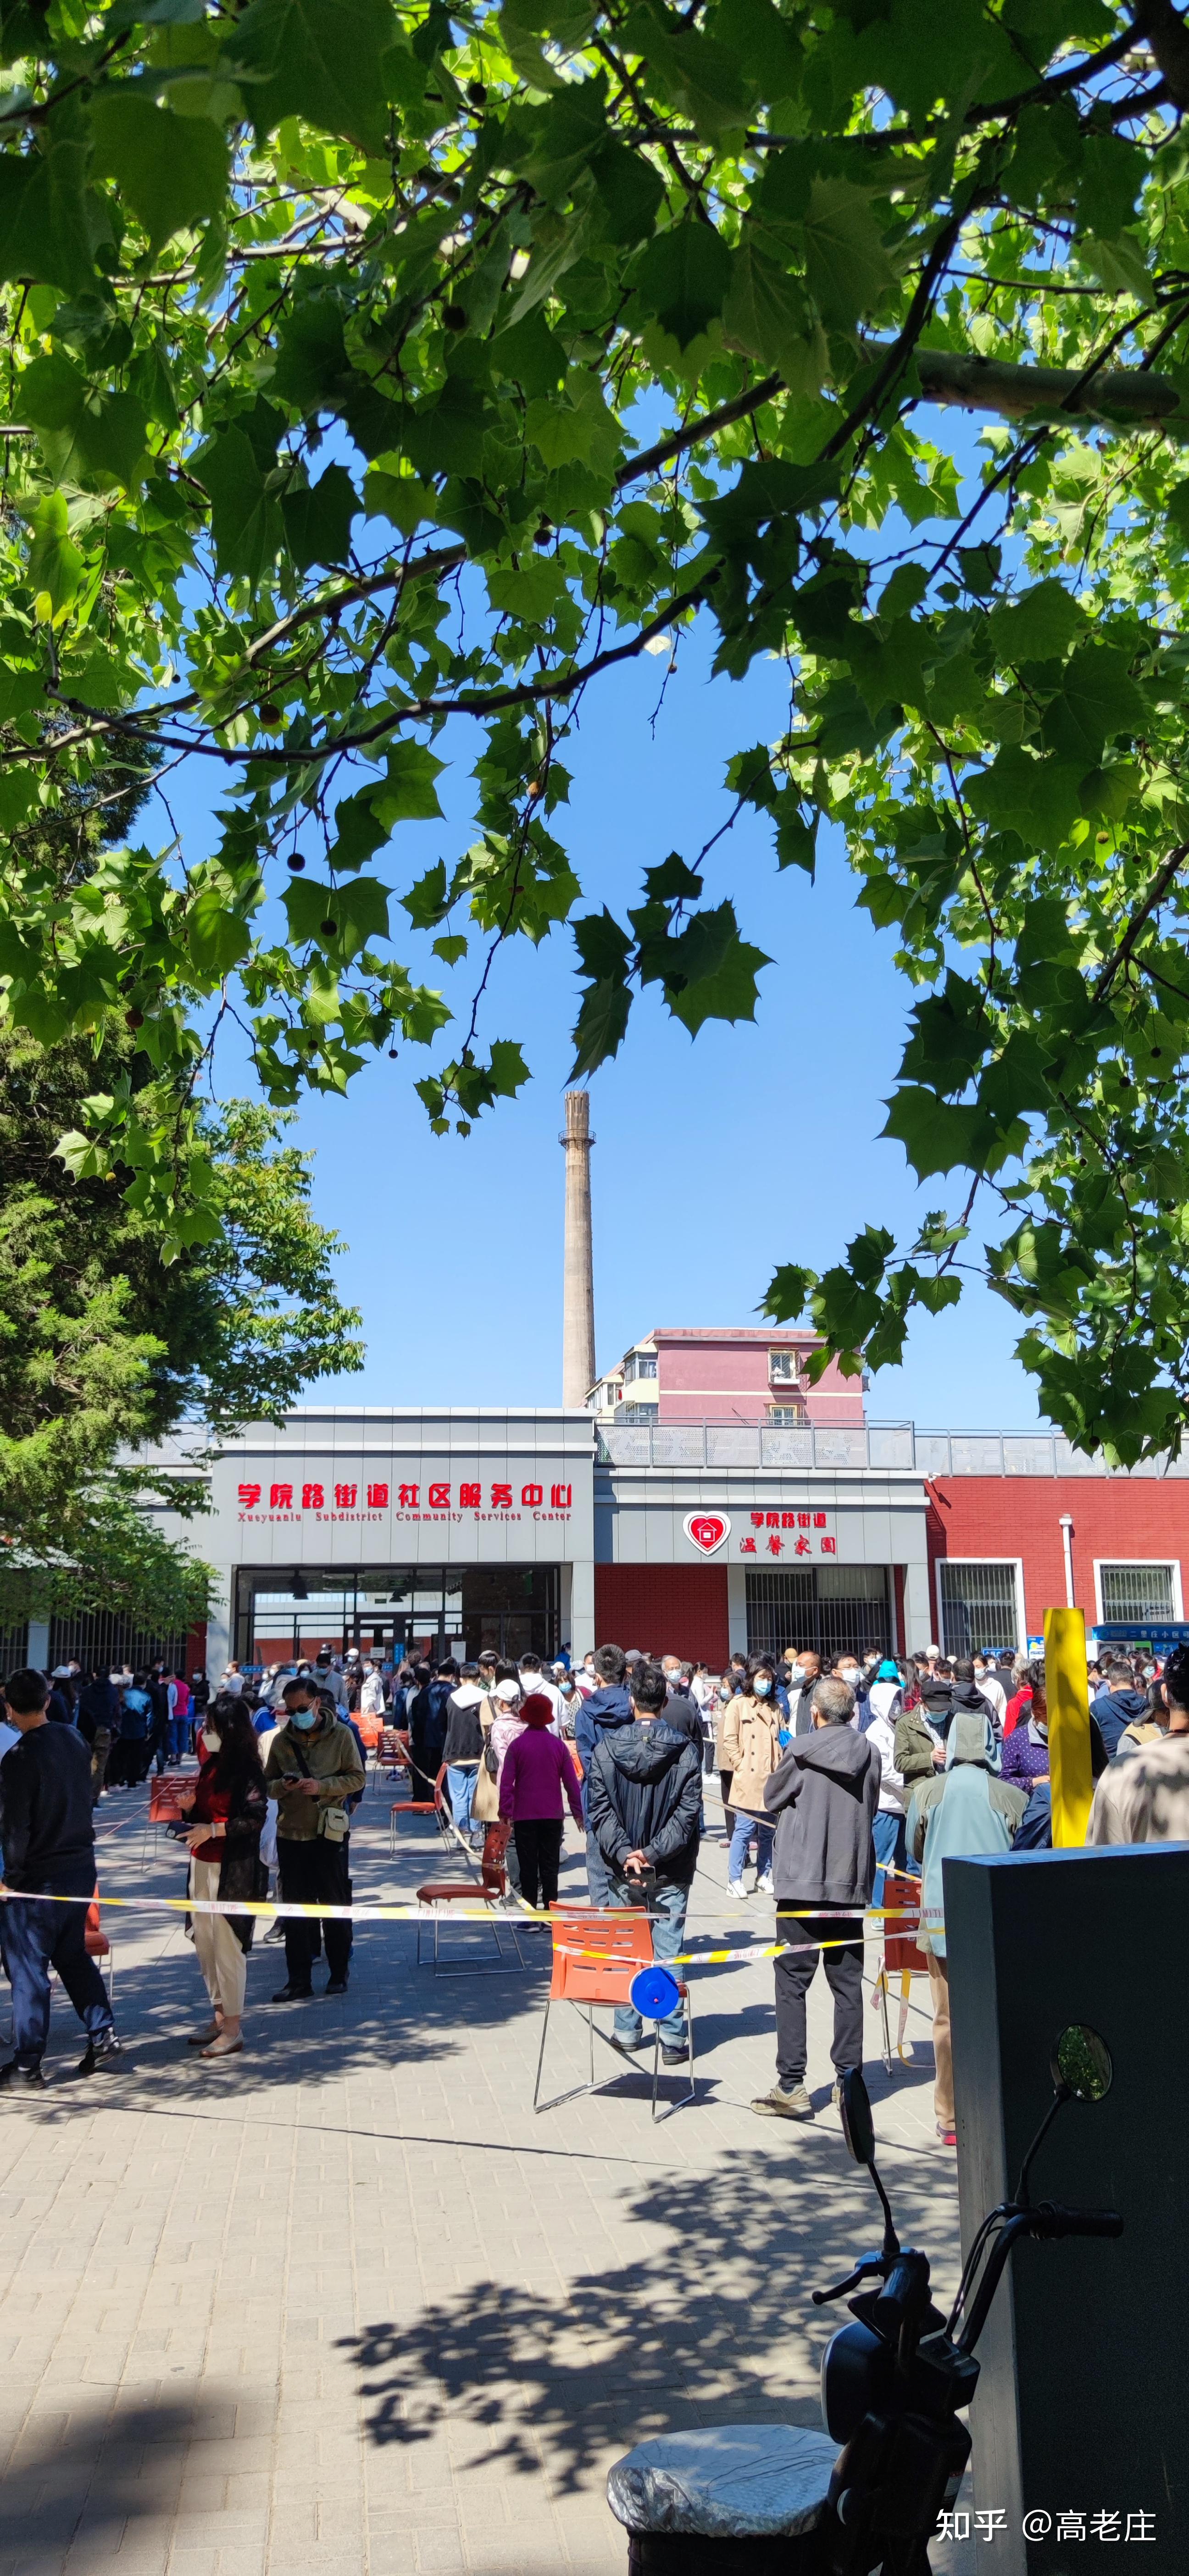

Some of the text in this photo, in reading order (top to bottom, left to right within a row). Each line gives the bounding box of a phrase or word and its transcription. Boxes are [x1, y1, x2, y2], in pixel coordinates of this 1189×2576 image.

[238, 1483, 572, 1509] 学院路街道社区服务中心
[238, 1511, 572, 1524] Xueyuanlu Subdistrict Community Services Center
[750, 1512, 827, 1528] 学院路街道
